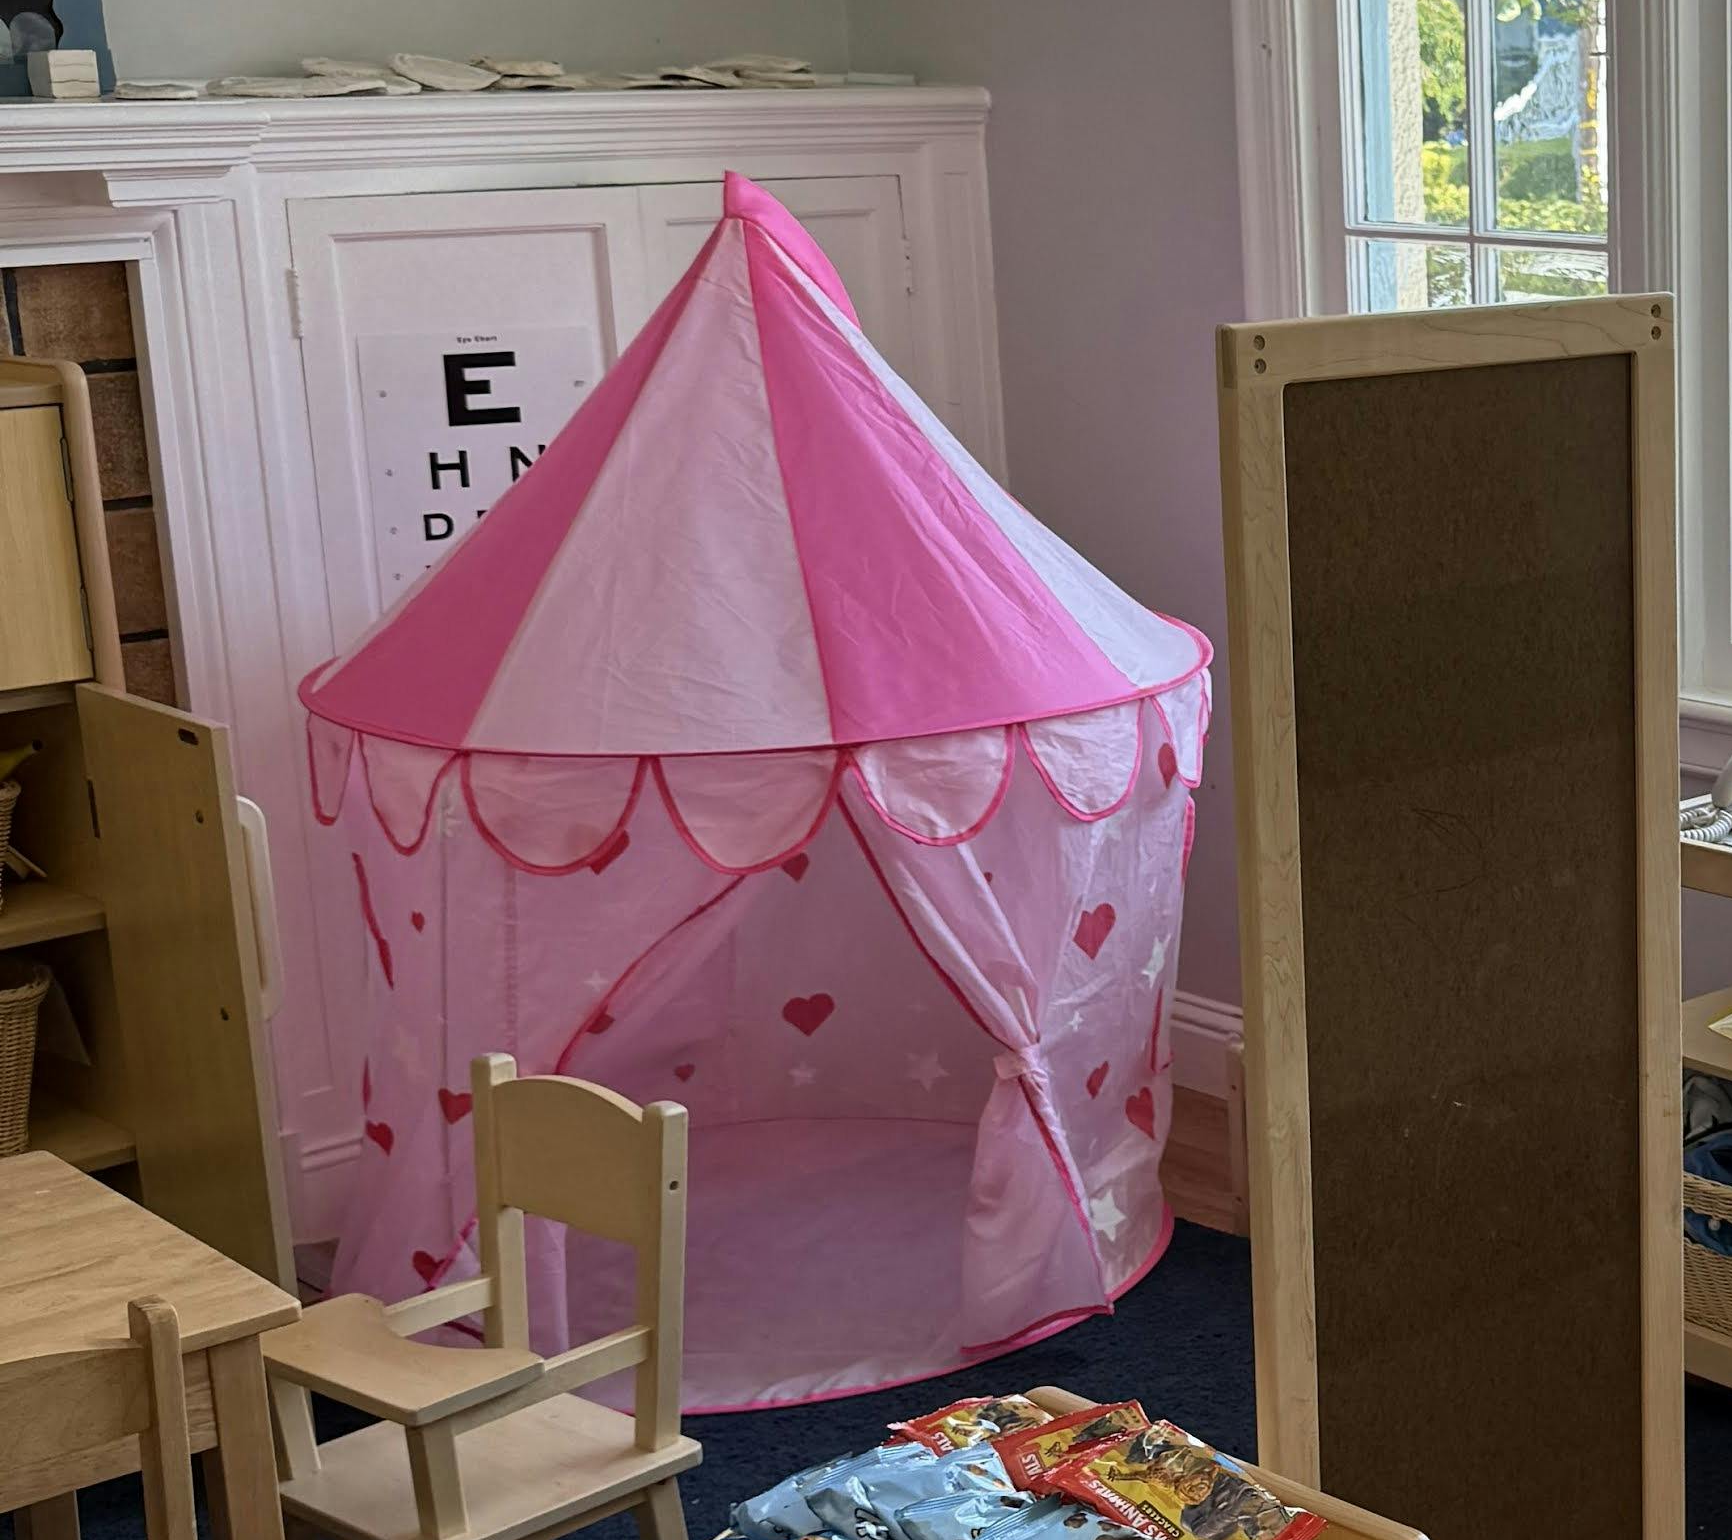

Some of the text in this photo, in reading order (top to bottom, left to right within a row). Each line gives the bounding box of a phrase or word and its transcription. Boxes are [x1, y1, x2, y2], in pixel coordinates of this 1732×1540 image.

[443, 351, 522, 427] E
[429, 450, 471, 490] H
[423, 513, 455, 541] D
